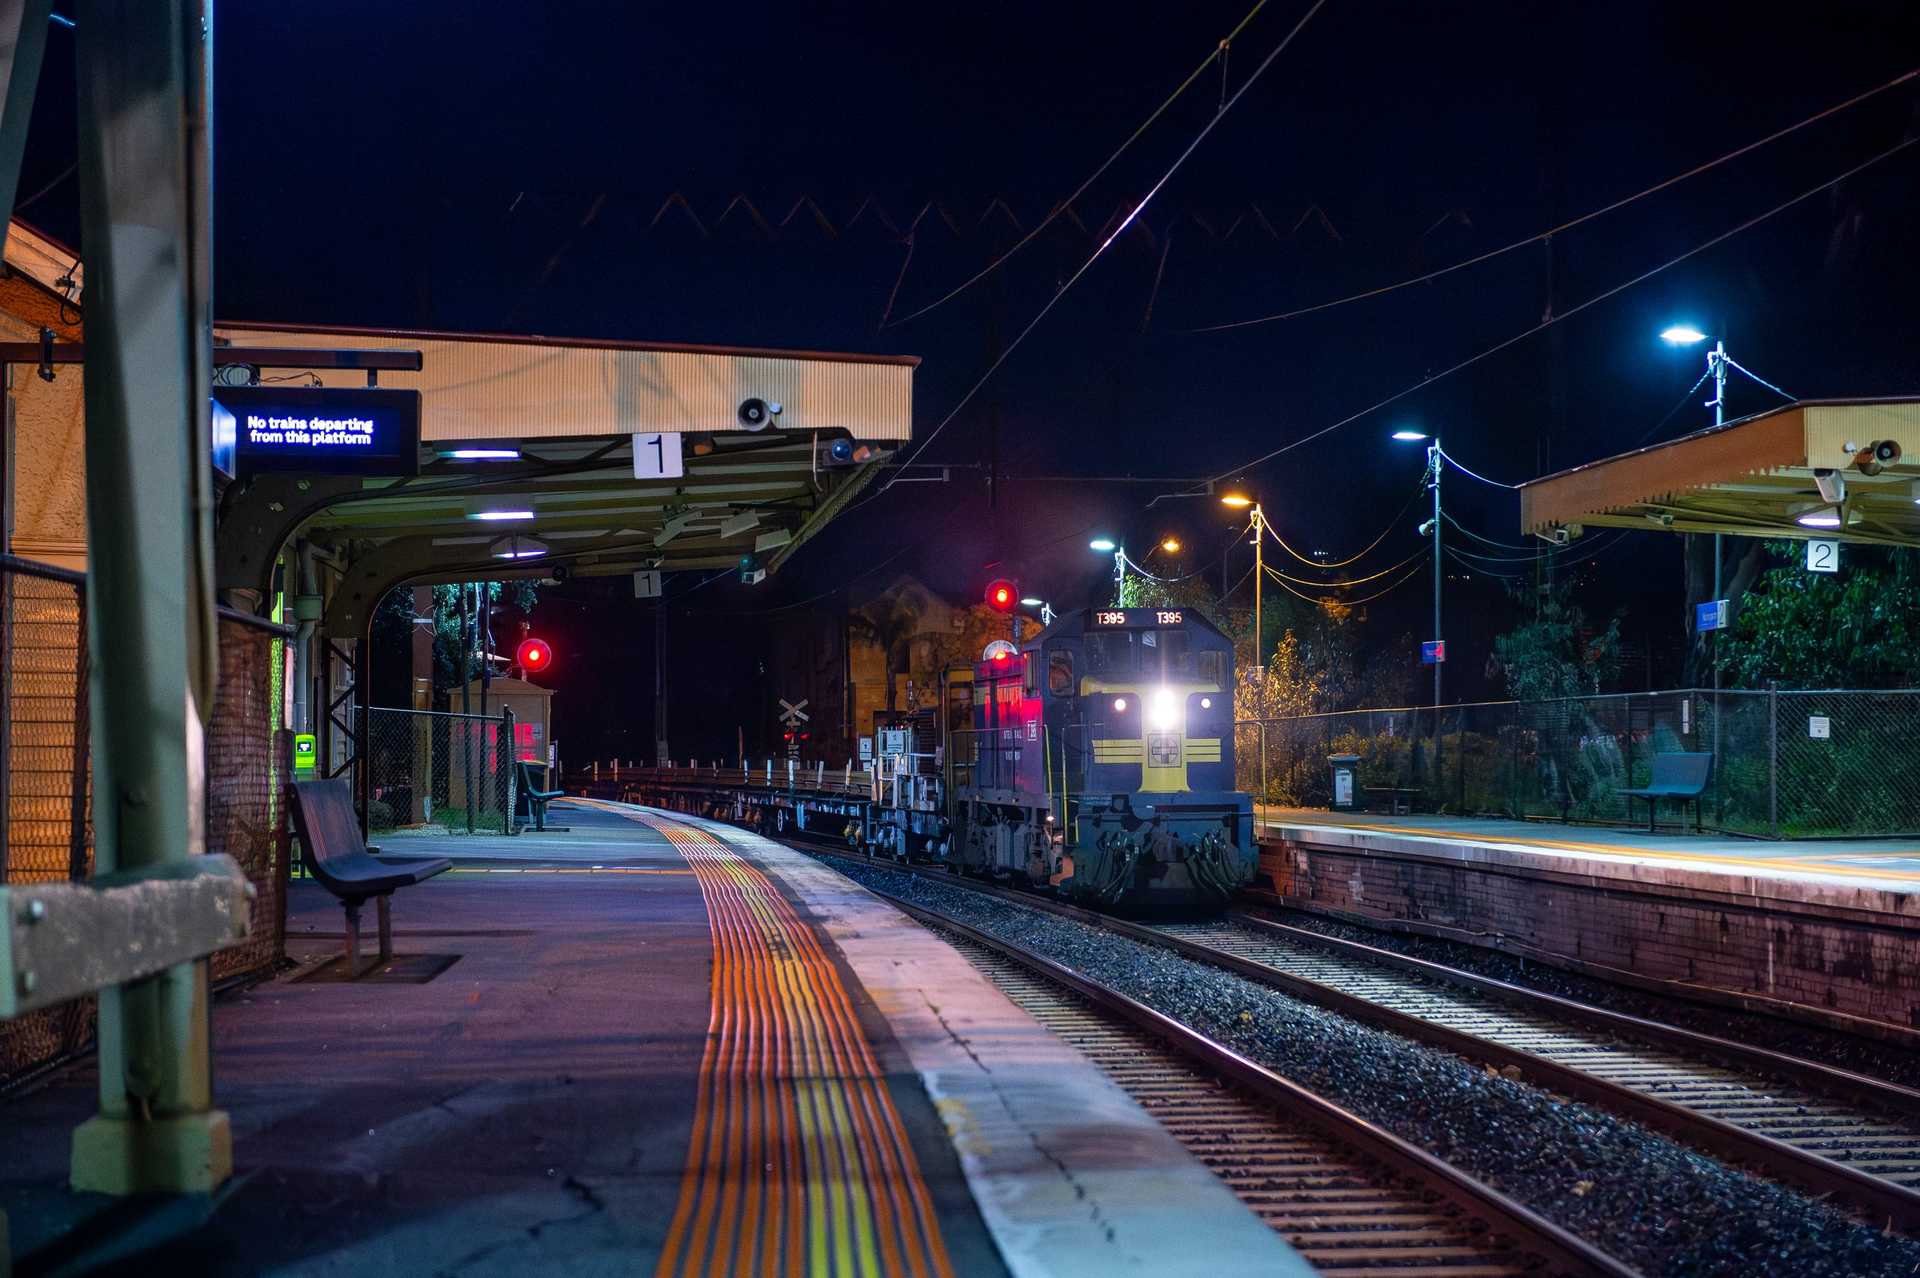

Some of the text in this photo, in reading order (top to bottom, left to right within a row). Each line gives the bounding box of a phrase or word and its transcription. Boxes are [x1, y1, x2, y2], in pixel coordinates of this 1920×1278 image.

[247, 415, 374, 434] No trains departing
[250, 429, 372, 446] from this platform
[647, 434, 664, 474] 1
[1814, 543, 1832, 569] 2
[641, 572, 652, 594] 1
[1096, 611, 1126, 625] T395
[1156, 611, 1183, 625] T395
